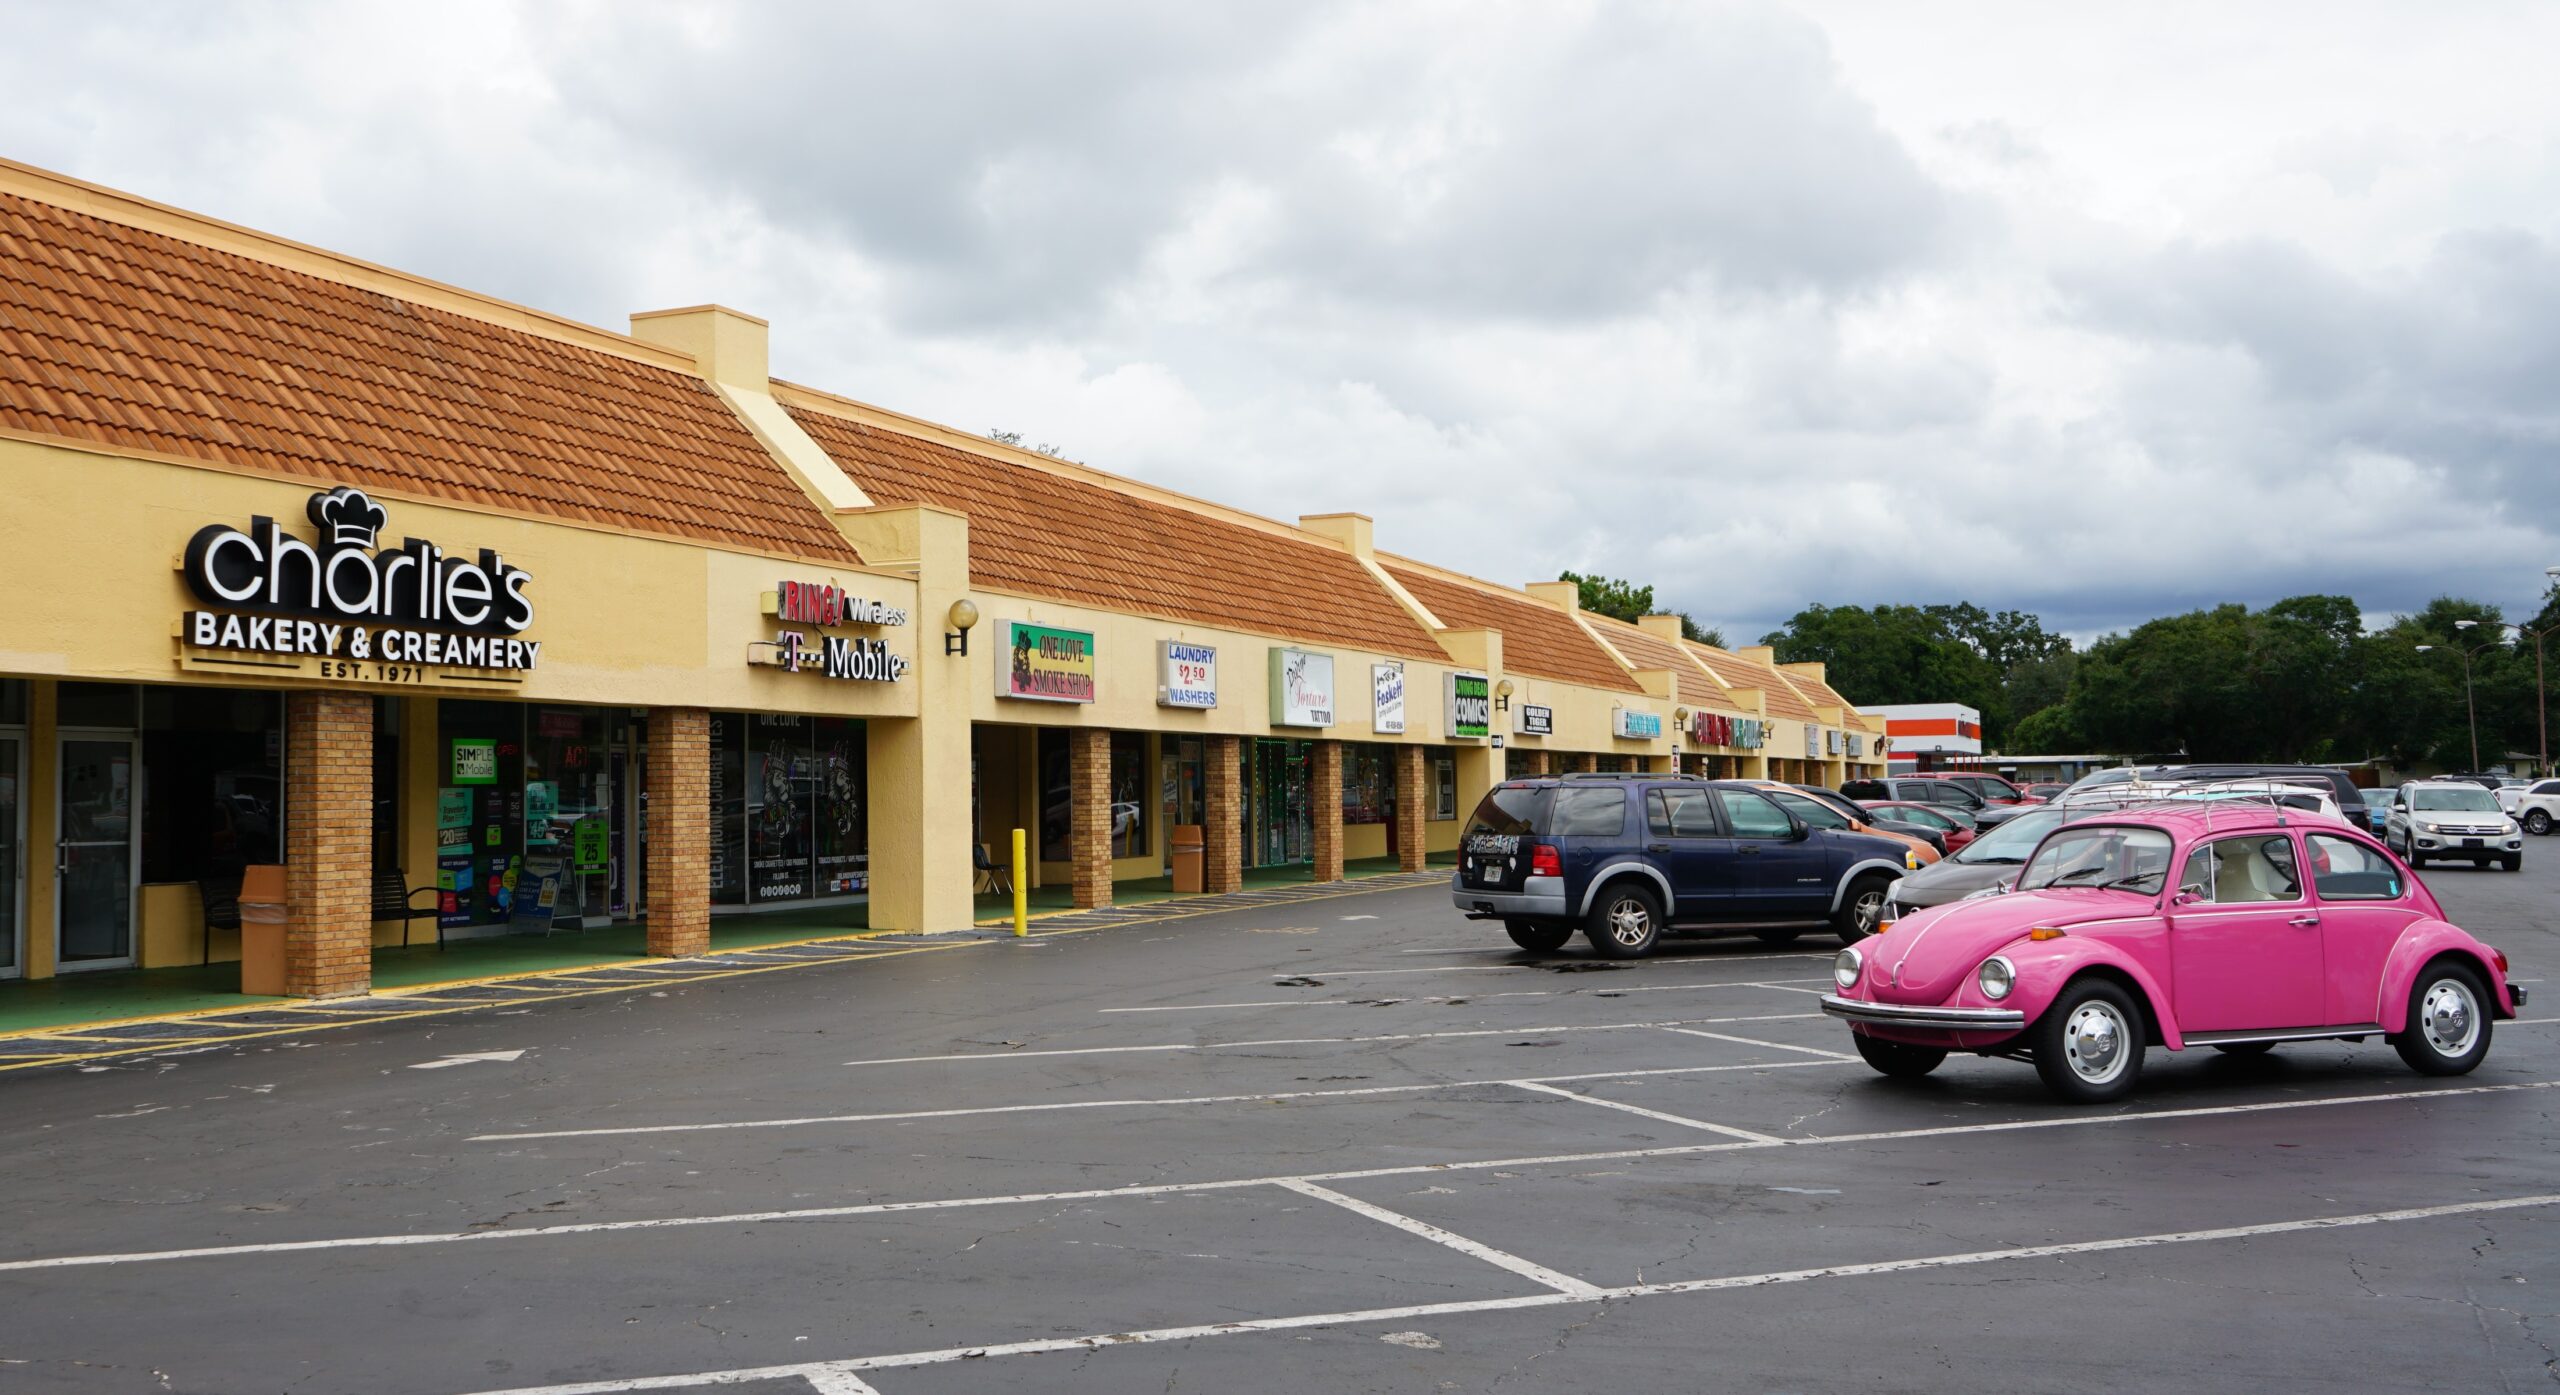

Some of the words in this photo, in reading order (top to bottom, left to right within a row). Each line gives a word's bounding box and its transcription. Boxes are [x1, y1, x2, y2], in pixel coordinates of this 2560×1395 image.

[204, 522, 534, 631] charlie's
[787, 580, 845, 627] RING!
[849, 597, 907, 625] Wireless
[195, 611, 341, 656] BAKERY
[351, 627, 371, 659] &
[381, 629, 541, 670] CREAMERY
[1039, 635, 1058, 661] ONE
[1059, 637, 1084, 662] LOVE
[1169, 645, 1214, 664] LAUNDRY
[321, 662, 369, 681] EST.
[378, 666, 422, 683] 1971
[1033, 669, 1066, 694] SMOKE
[1067, 674, 1090, 696] SHOP
[1456, 679, 1474, 695] LIVING
[1474, 681, 1487, 696] DEAD
[1170, 688, 1215, 705] WASHERS
[1310, 710, 1331, 723] TATTOO
[1456, 698, 1487, 723] COMICS
[1526, 707, 1549, 718] GOLDEN
[1529, 717, 1547, 726] TIGER
[456, 748, 493, 761] SIMPLE
[466, 763, 493, 775] Mobile
